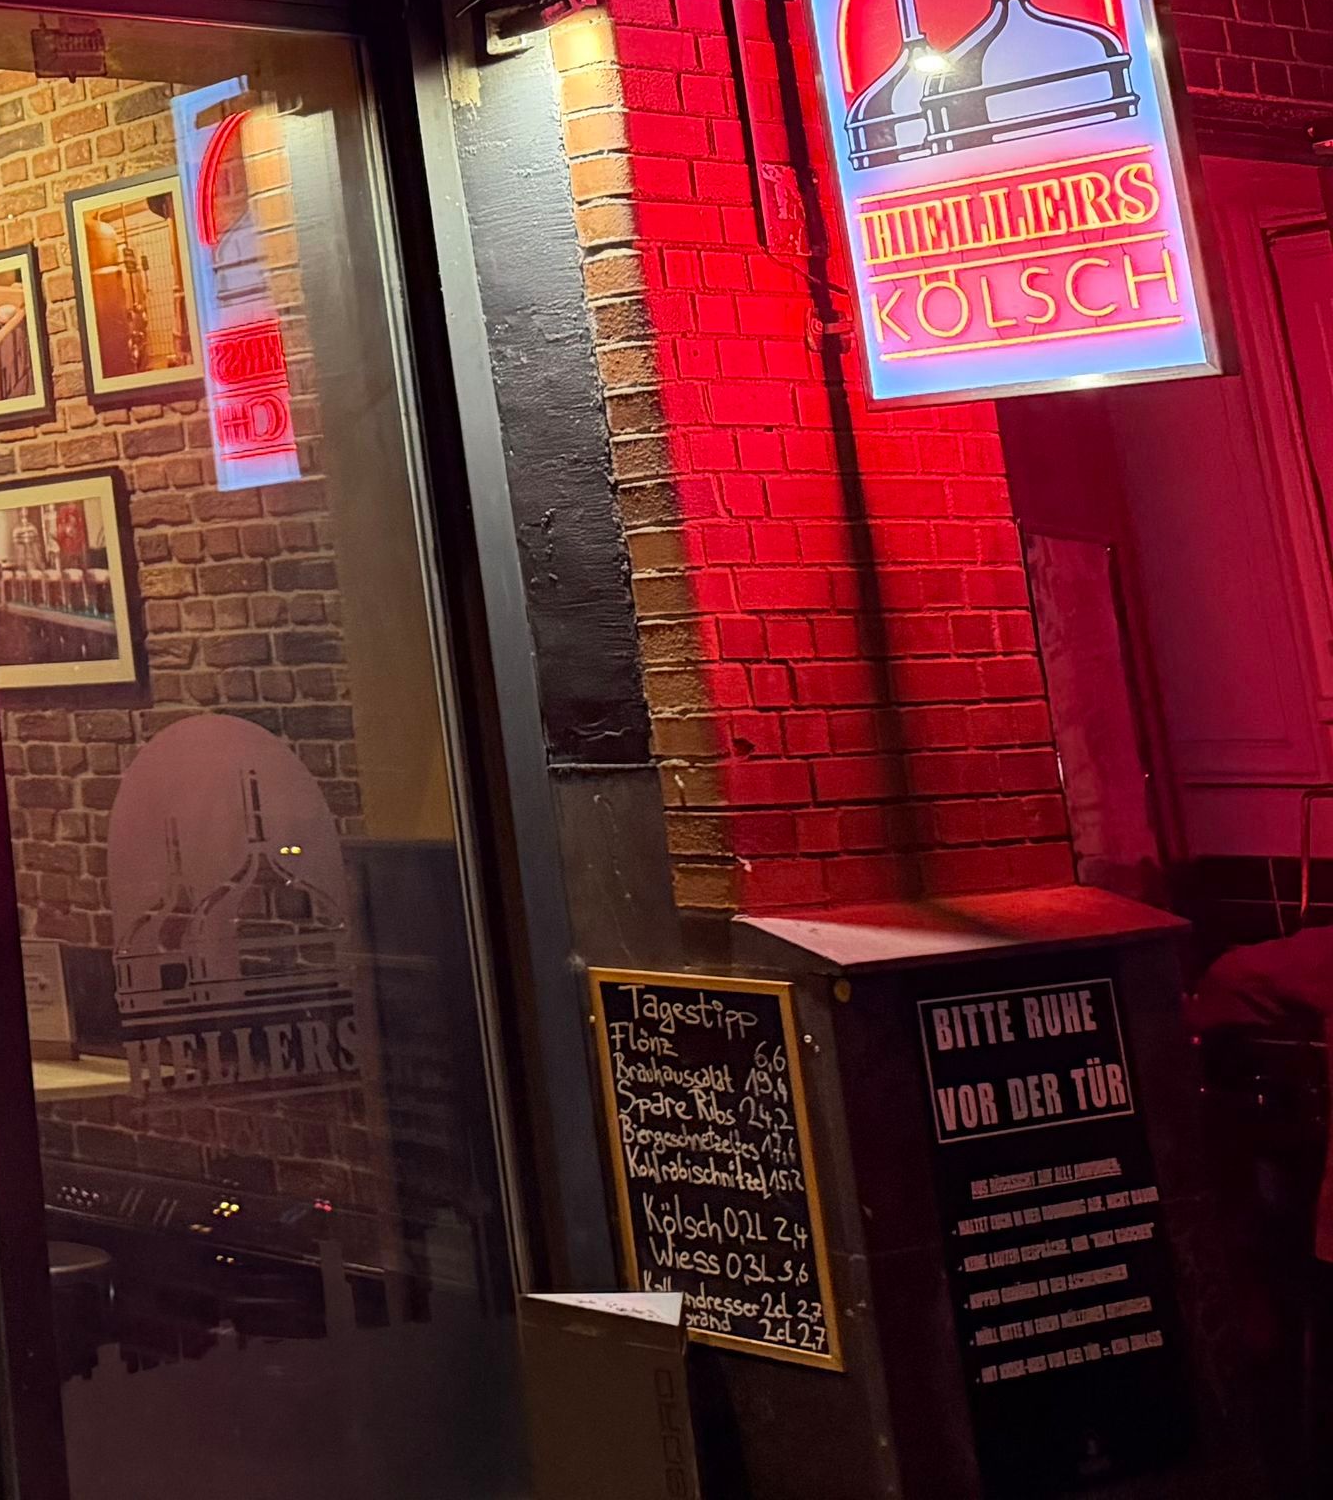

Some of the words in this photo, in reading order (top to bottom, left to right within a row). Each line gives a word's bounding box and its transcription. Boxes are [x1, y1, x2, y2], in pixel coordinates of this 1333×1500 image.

[854, 161, 1162, 266] HELLERS
[868, 248, 1180, 345] KÖLSCH
[609, 1020, 679, 1058] Flönz
[617, 984, 759, 1041] Tagestipp
[932, 1000, 1015, 1051] BITTE
[1023, 989, 1097, 1040] RUHE
[122, 1014, 362, 1095] HELLERS
[617, 1078, 694, 1124] Spare
[687, 1088, 737, 1127] Ribs
[739, 1095, 795, 1132] 24,2
[936, 1082, 999, 1132] VOR
[1006, 1072, 1064, 1121] DER
[1069, 1056, 1127, 1111] TÜR
[624, 1144, 772, 1200] Kohlrabischnitzel
[642, 1191, 724, 1246] Kölsch
[773, 1215, 810, 1251] 2,4
[648, 1235, 722, 1277] Wiess
[776, 1258, 811, 1288] 3,6
